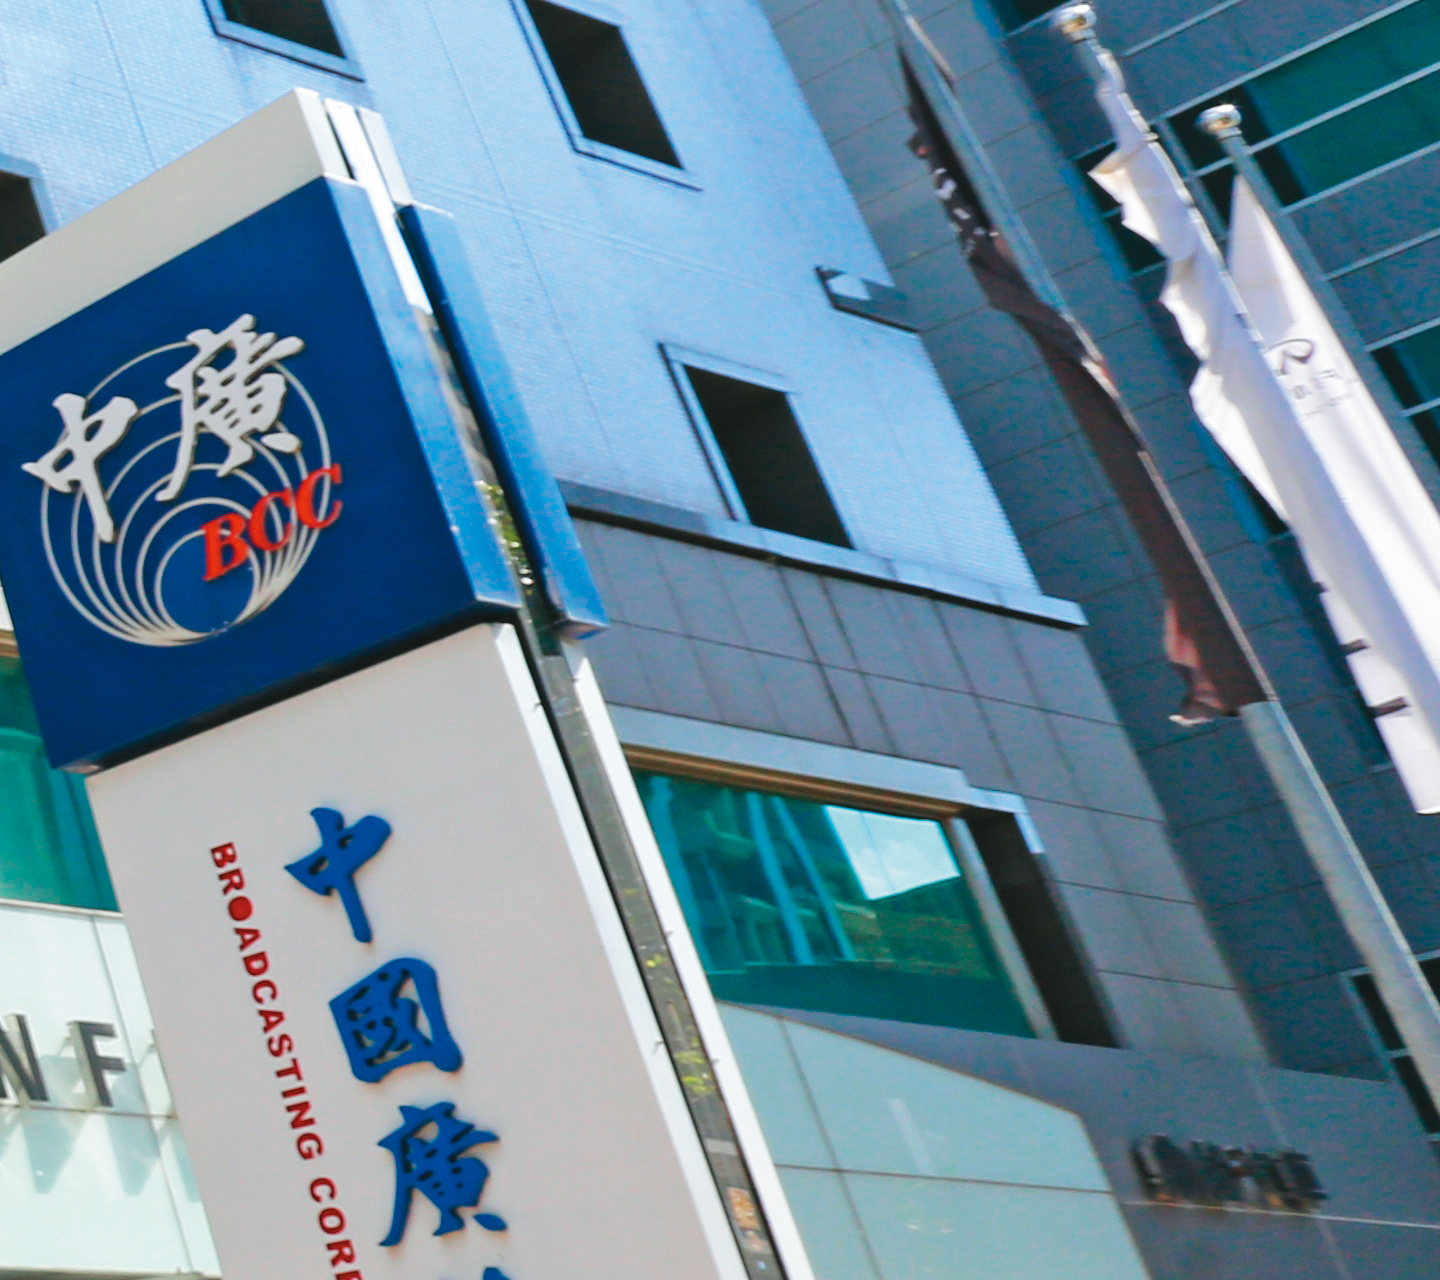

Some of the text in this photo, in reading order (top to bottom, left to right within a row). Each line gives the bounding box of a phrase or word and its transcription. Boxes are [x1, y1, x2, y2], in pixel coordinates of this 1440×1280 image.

[21, 313, 306, 544] 中廣
[200, 463, 344, 582] BCC
[209, 840, 325, 1161] BROADCASTING
